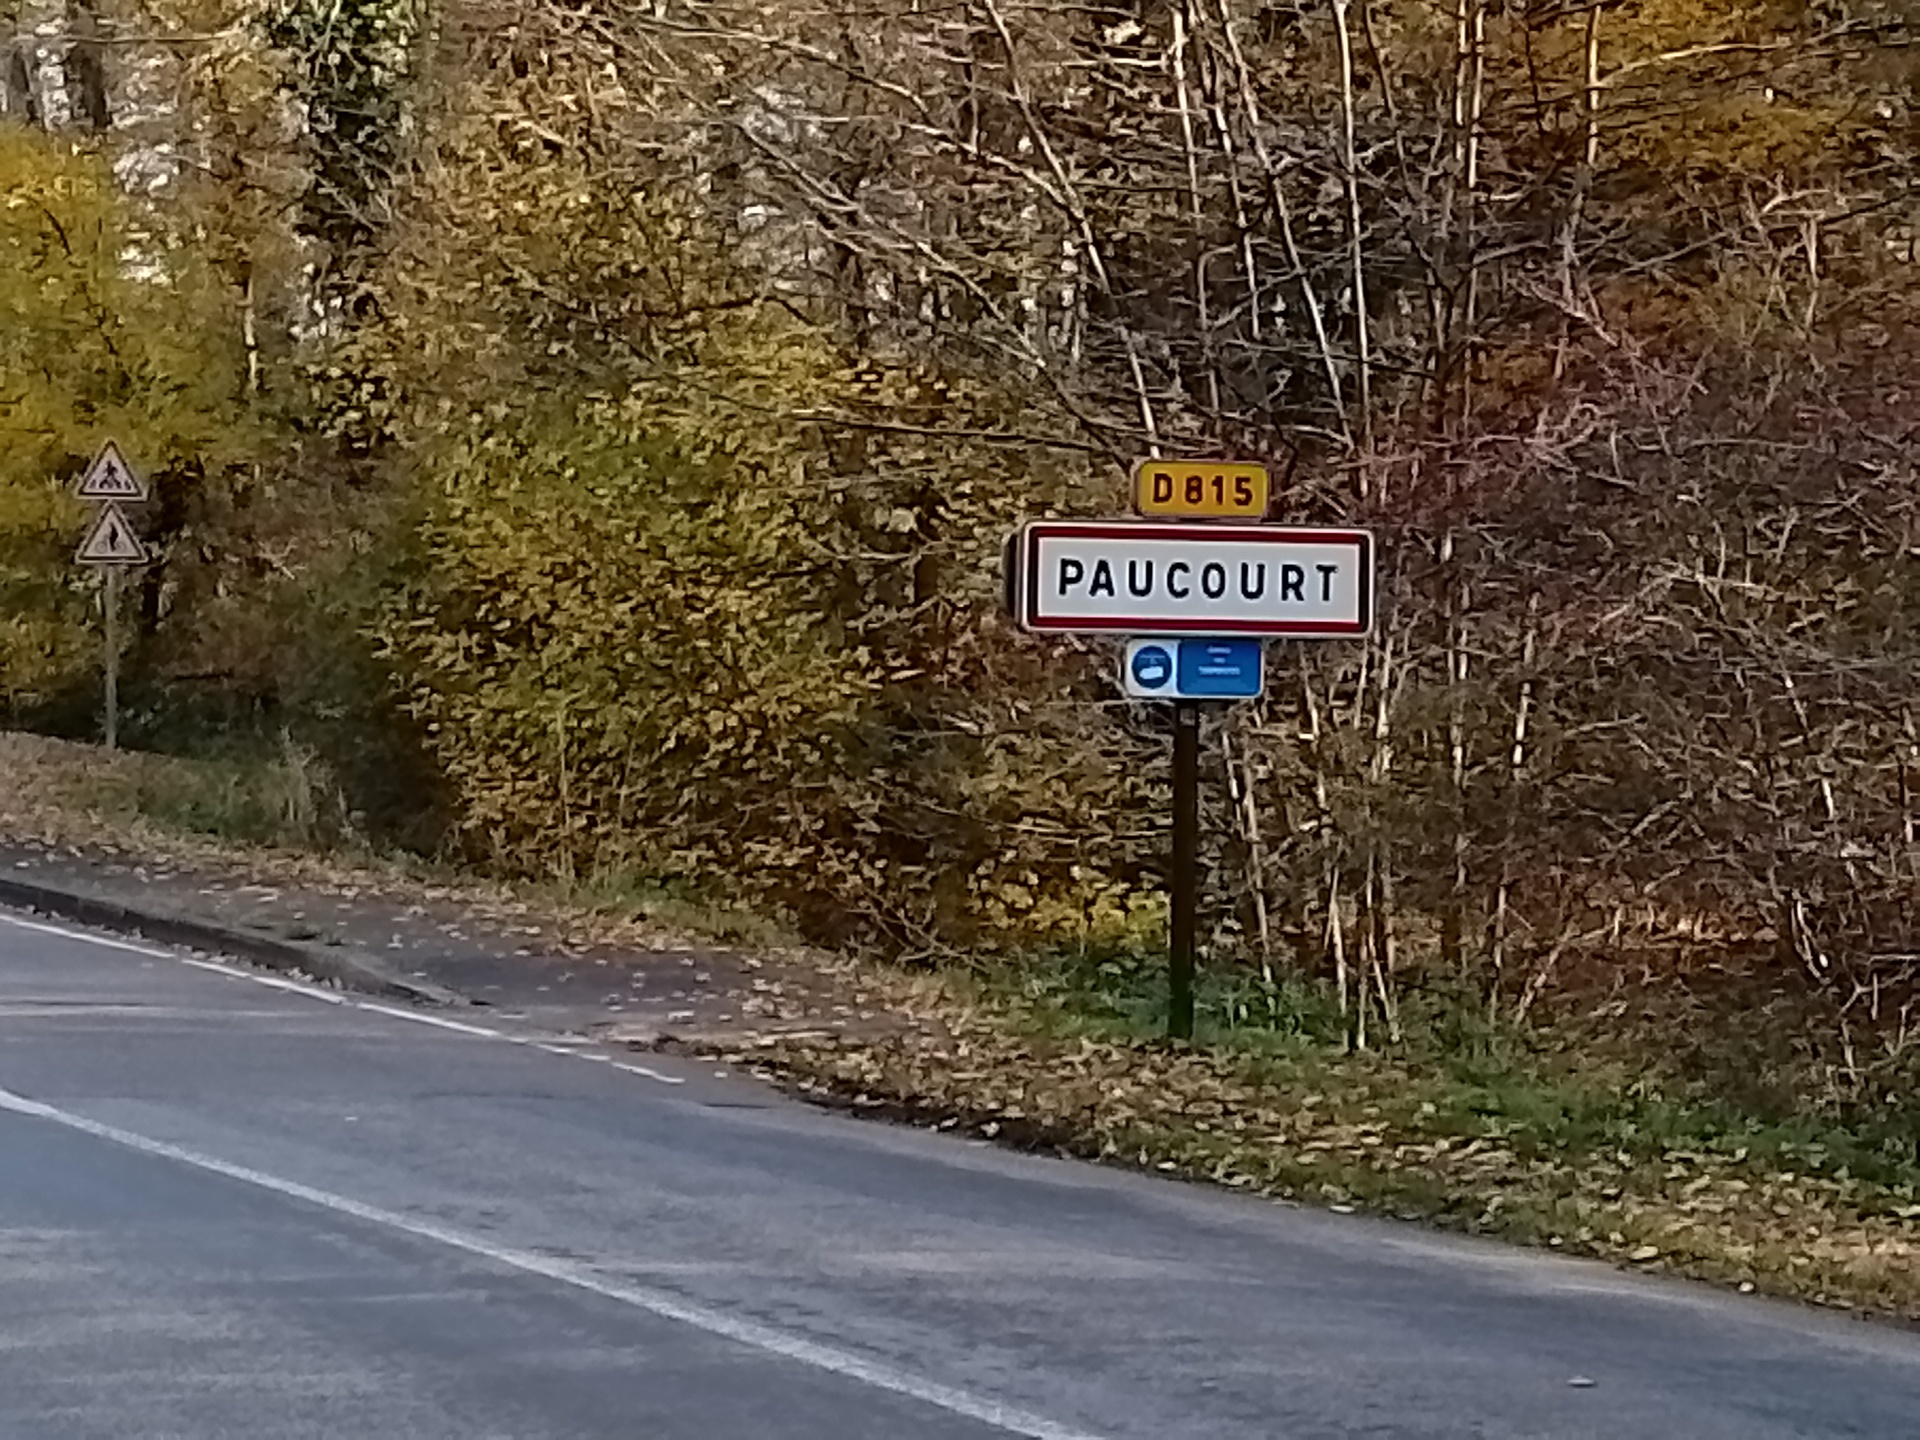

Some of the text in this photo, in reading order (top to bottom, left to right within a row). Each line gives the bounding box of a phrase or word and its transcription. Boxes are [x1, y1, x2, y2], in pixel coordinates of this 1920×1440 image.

[1152, 473, 1254, 507] D 815
[1058, 558, 1339, 602] PAUCOURT
